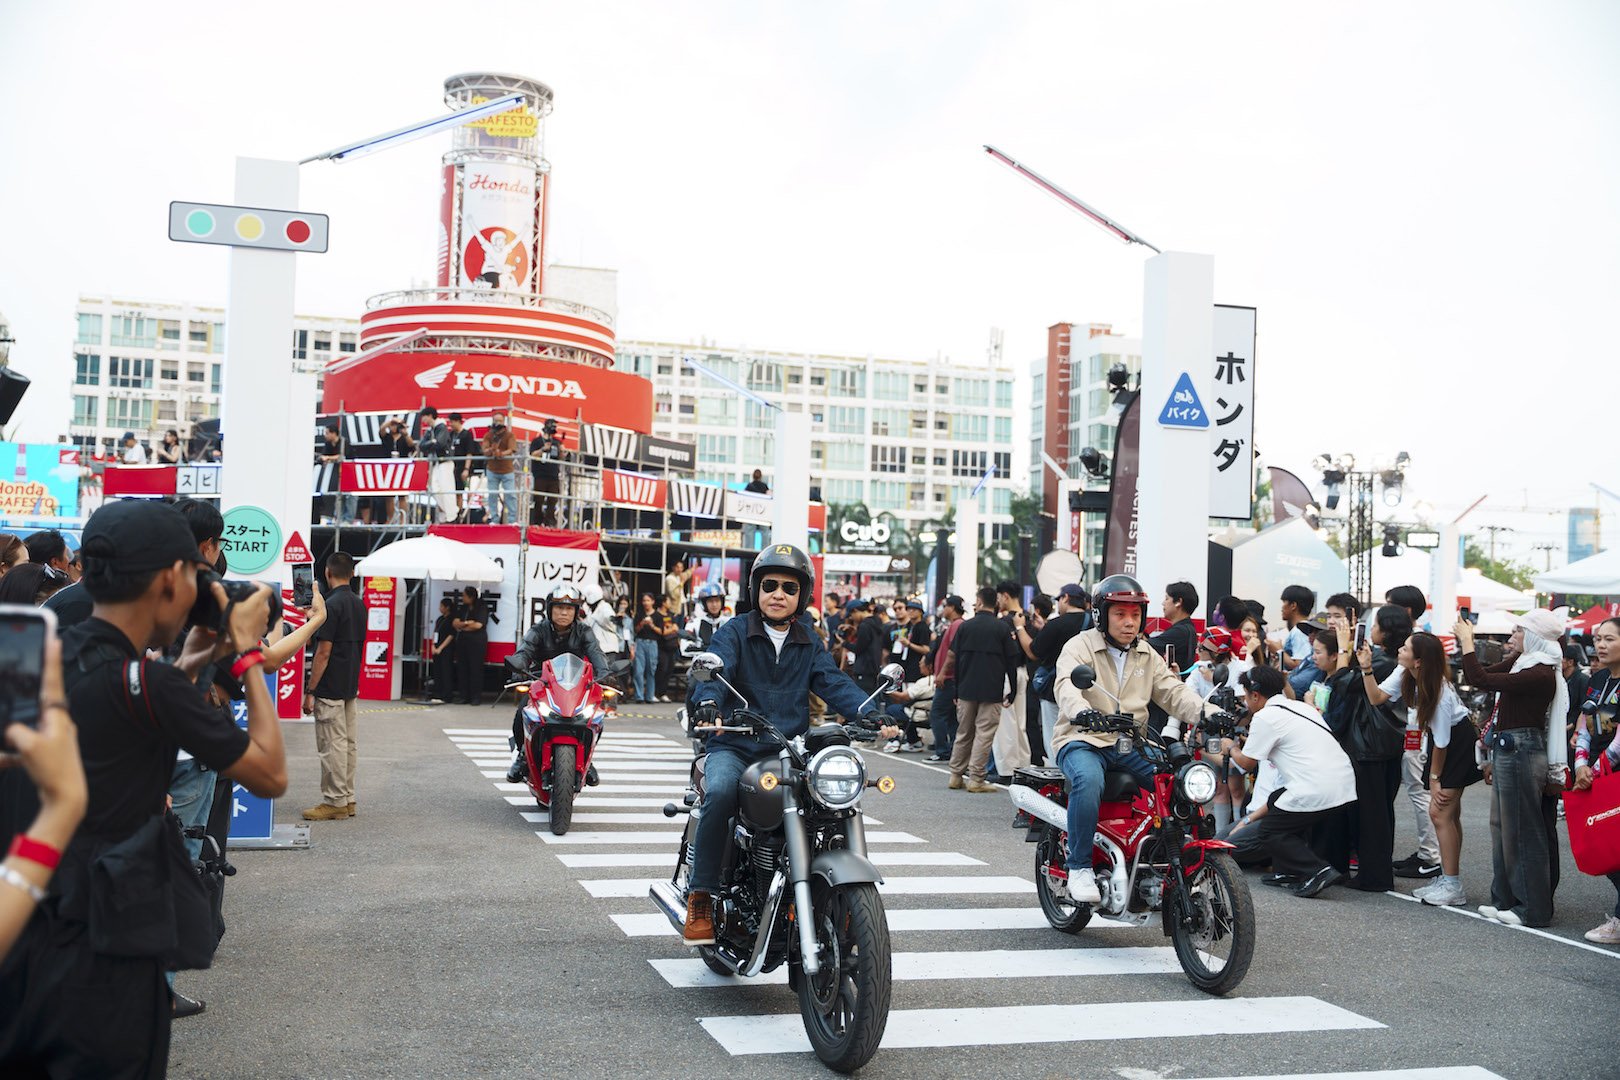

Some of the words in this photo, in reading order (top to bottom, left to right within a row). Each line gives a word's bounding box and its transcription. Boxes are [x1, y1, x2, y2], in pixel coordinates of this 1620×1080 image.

[469, 173, 531, 195] Honda
[453, 370, 587, 401] HONDA
[1167, 405, 1201, 422] バイク
[1213, 351, 1246, 473] ホンダ
[737, 499, 766, 514] ジャパン
[226, 525, 271, 537] スタート
[840, 518, 891, 543] Cub
[225, 541, 269, 553] START
[533, 562, 588, 583] バンゴク
